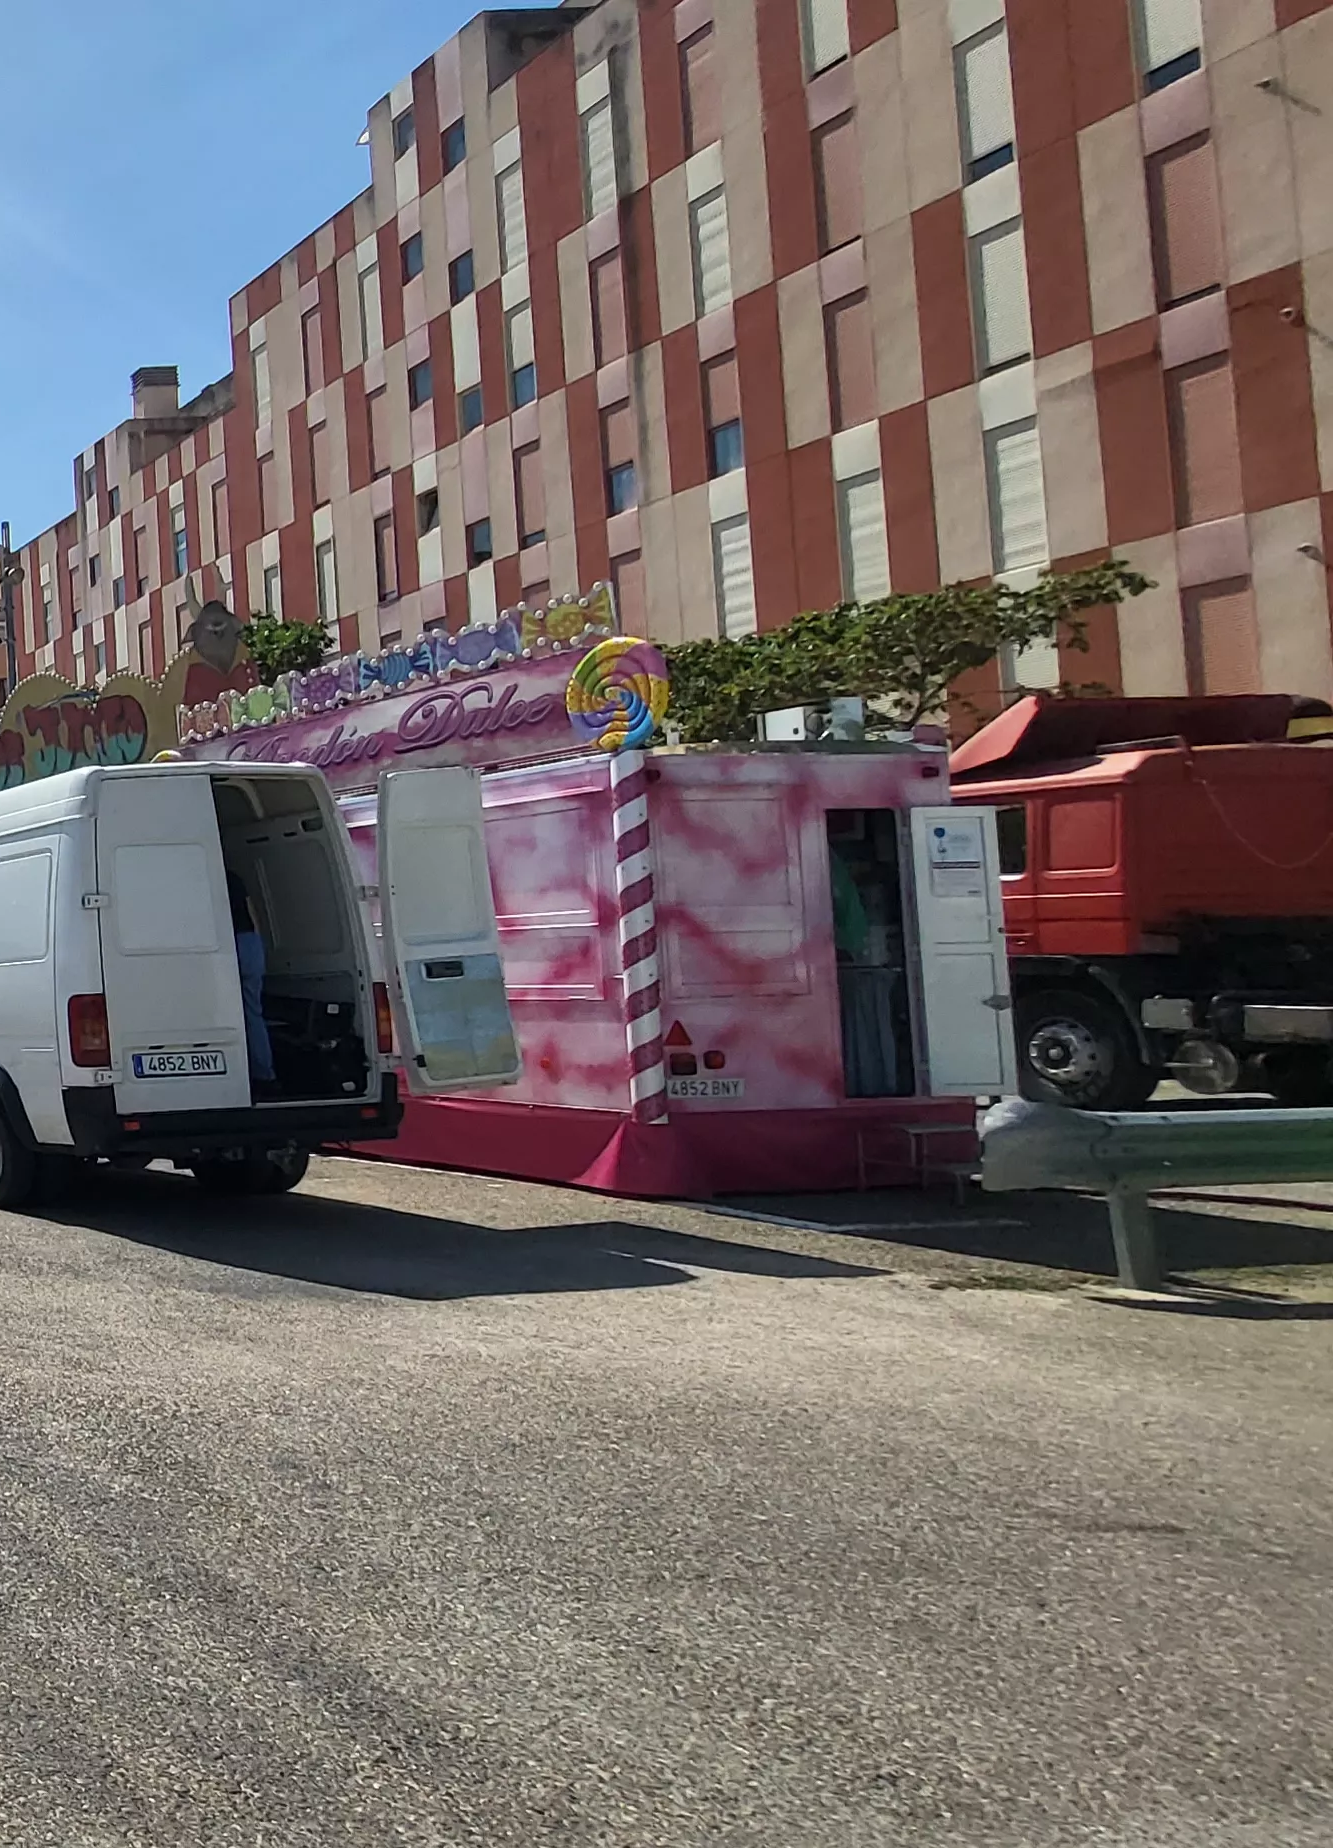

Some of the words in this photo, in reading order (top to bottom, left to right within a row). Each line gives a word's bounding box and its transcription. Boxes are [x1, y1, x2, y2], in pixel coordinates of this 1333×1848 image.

[393, 683, 554, 753] Dulce
[148, 1055, 186, 1072] 4852
[191, 1054, 218, 1071] BNY
[670, 1080, 709, 1097] 4852
[712, 1080, 740, 1096] BNY
